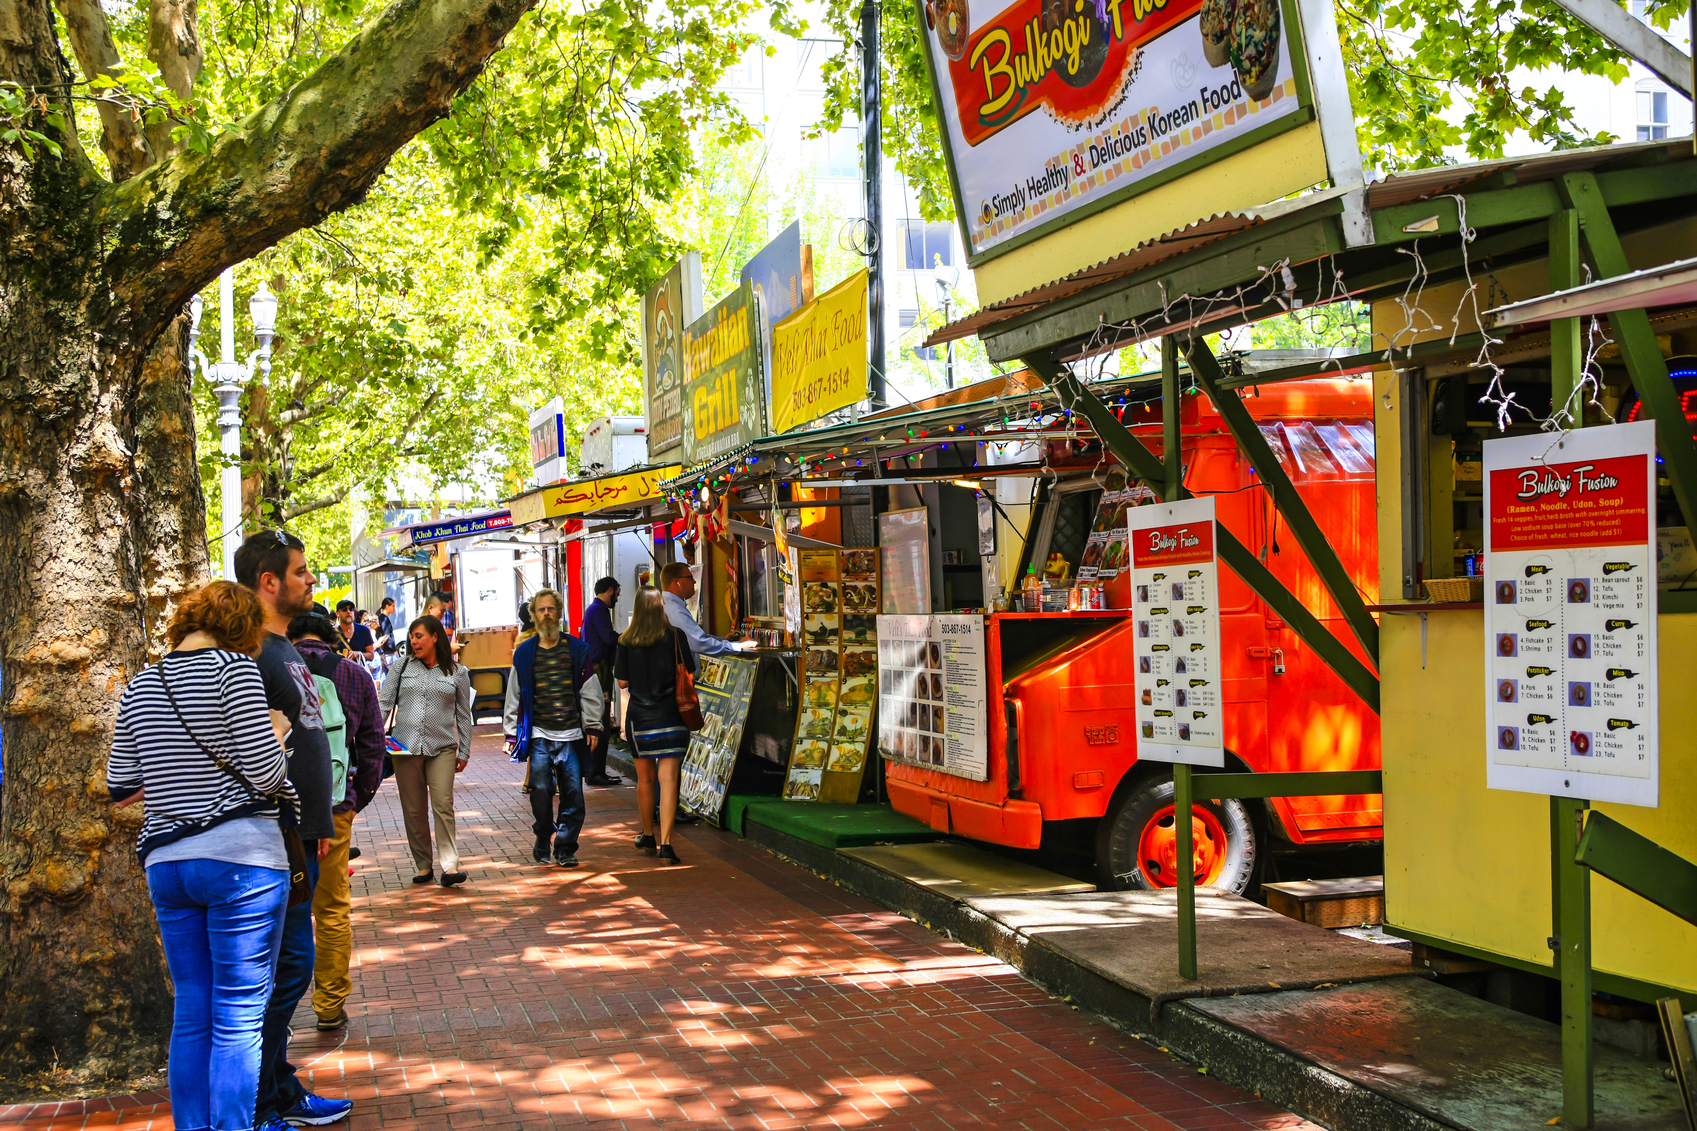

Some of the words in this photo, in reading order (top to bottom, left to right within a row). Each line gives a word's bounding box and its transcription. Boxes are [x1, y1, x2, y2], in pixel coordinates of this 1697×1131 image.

[969, 0, 1090, 116] Bulkogi
[991, 183, 1026, 218] Simply
[1026, 164, 1068, 200] Healthy
[1073, 153, 1086, 177] &
[1089, 126, 1147, 169] Delicious
[1147, 101, 1199, 140] Korean
[1199, 70, 1242, 115] Food
[801, 315, 828, 368] Thai
[831, 287, 868, 353] Food
[682, 304, 750, 387] Hawaiian
[793, 365, 850, 412] 503-867-1514
[694, 366, 740, 442] Grill
[1517, 469, 1571, 498] Bulkogi
[1572, 465, 1618, 494] Fusion
[1507, 505, 1538, 514] (Ramen,
[1540, 502, 1570, 511] Noodle,
[1572, 500, 1596, 509] Udon,
[1599, 496, 1624, 507] Soup)
[1575, 510, 1587, 518] with
[1588, 509, 1615, 517] overnight
[454, 524, 468, 533] Thai
[1597, 518, 1621, 526] reduced)
[1613, 528, 1622, 536] $1)
[1605, 563, 1630, 571] Vegetable
[941, 623, 972, 635] 503-867-1514
